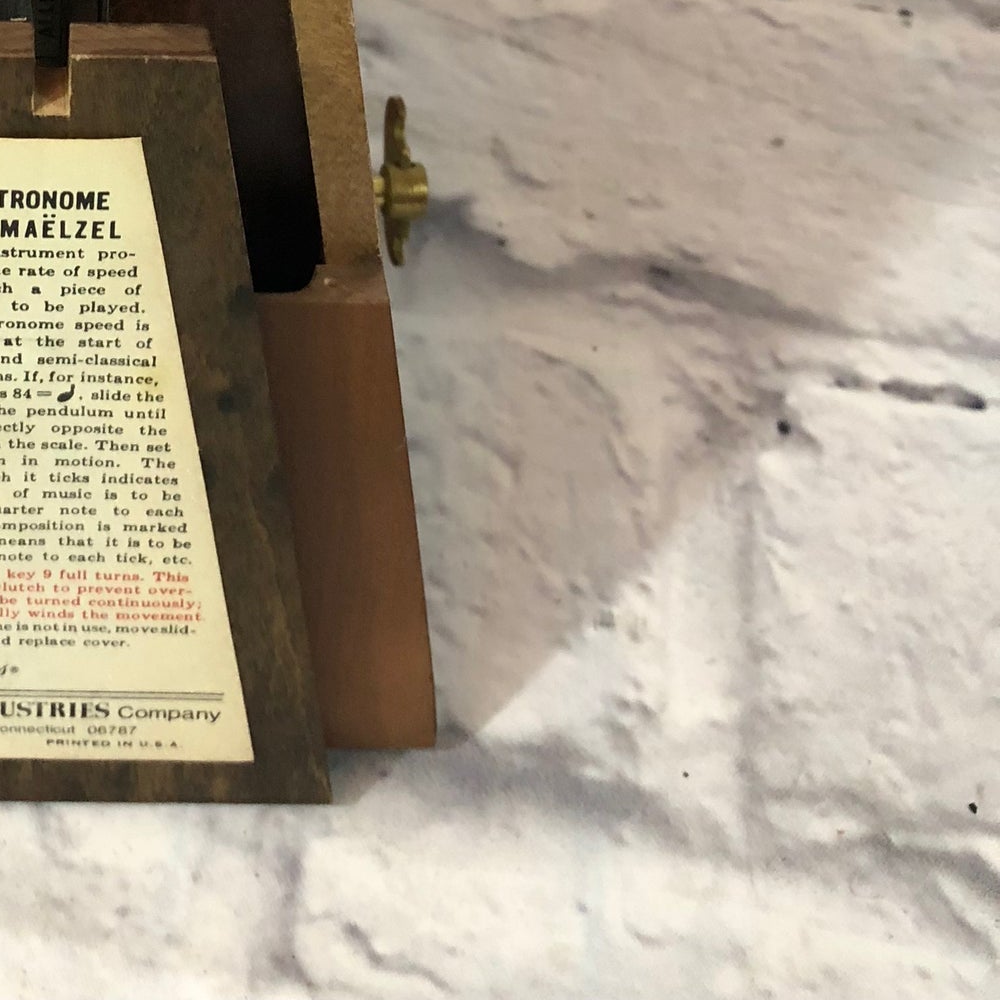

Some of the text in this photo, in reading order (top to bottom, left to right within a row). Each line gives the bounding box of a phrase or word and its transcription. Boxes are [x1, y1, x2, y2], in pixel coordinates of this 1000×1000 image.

[0, 214, 121, 240] MAËLZEL
[98, 251, 135, 262] pro-
[18, 266, 55, 277] rate
[63, 265, 80, 277] of
[88, 266, 138, 280] speed
[31, 286, 41, 294] a
[60, 283, 106, 297] piece
[124, 284, 142, 296] of
[11, 300, 29, 311] to
[44, 300, 64, 312] be
[79, 301, 145, 315] played.
[75, 319, 124, 332] speed
[136, 320, 149, 331] is
[4, 336, 22, 346] at
[36, 335, 64, 347] the
[78, 338, 121, 348] start
[136, 338, 152, 349] of
[37, 354, 156, 367] semi-classical
[24, 370, 43, 384] If,
[49, 371, 74, 382] for
[80, 371, 158, 387] instance,
[91, 389, 131, 401] slide
[137, 391, 164, 402] the
[26, 405, 113, 418] pendulum
[124, 408, 166, 419] until
[51, 423, 123, 436] opposite
[140, 425, 167, 436] the
[8, 438, 35, 449] the
[41, 439, 88, 450] scale.
[95, 440, 139, 452] Then
[146, 442, 171, 452] set
[22, 455, 38, 466] in
[55, 456, 120, 468] motion.
[141, 458, 176, 469] The
[24, 472, 36, 482] it
[49, 472, 89, 483] ticks
[102, 473, 178, 486] indicates
[13, 488, 29, 498] of
[42, 488, 92, 499] music
[104, 489, 117, 500] is
[131, 490, 148, 500] to
[162, 490, 181, 501] be
[60, 506, 96, 515] note
[114, 506, 130, 516] to
[146, 506, 184, 517] each
[98, 521, 110, 532] is
[123, 522, 187, 533] marked
[43, 552, 59, 561] to
[68, 552, 105, 562] each
[116, 553, 152, 565] tick,
[163, 555, 191, 564] etc.
[8, 569, 35, 580] key
[44, 570, 52, 578] 9
[60, 570, 86, 580] full
[153, 572, 188, 582] This
[118, 706, 220, 723] Company
